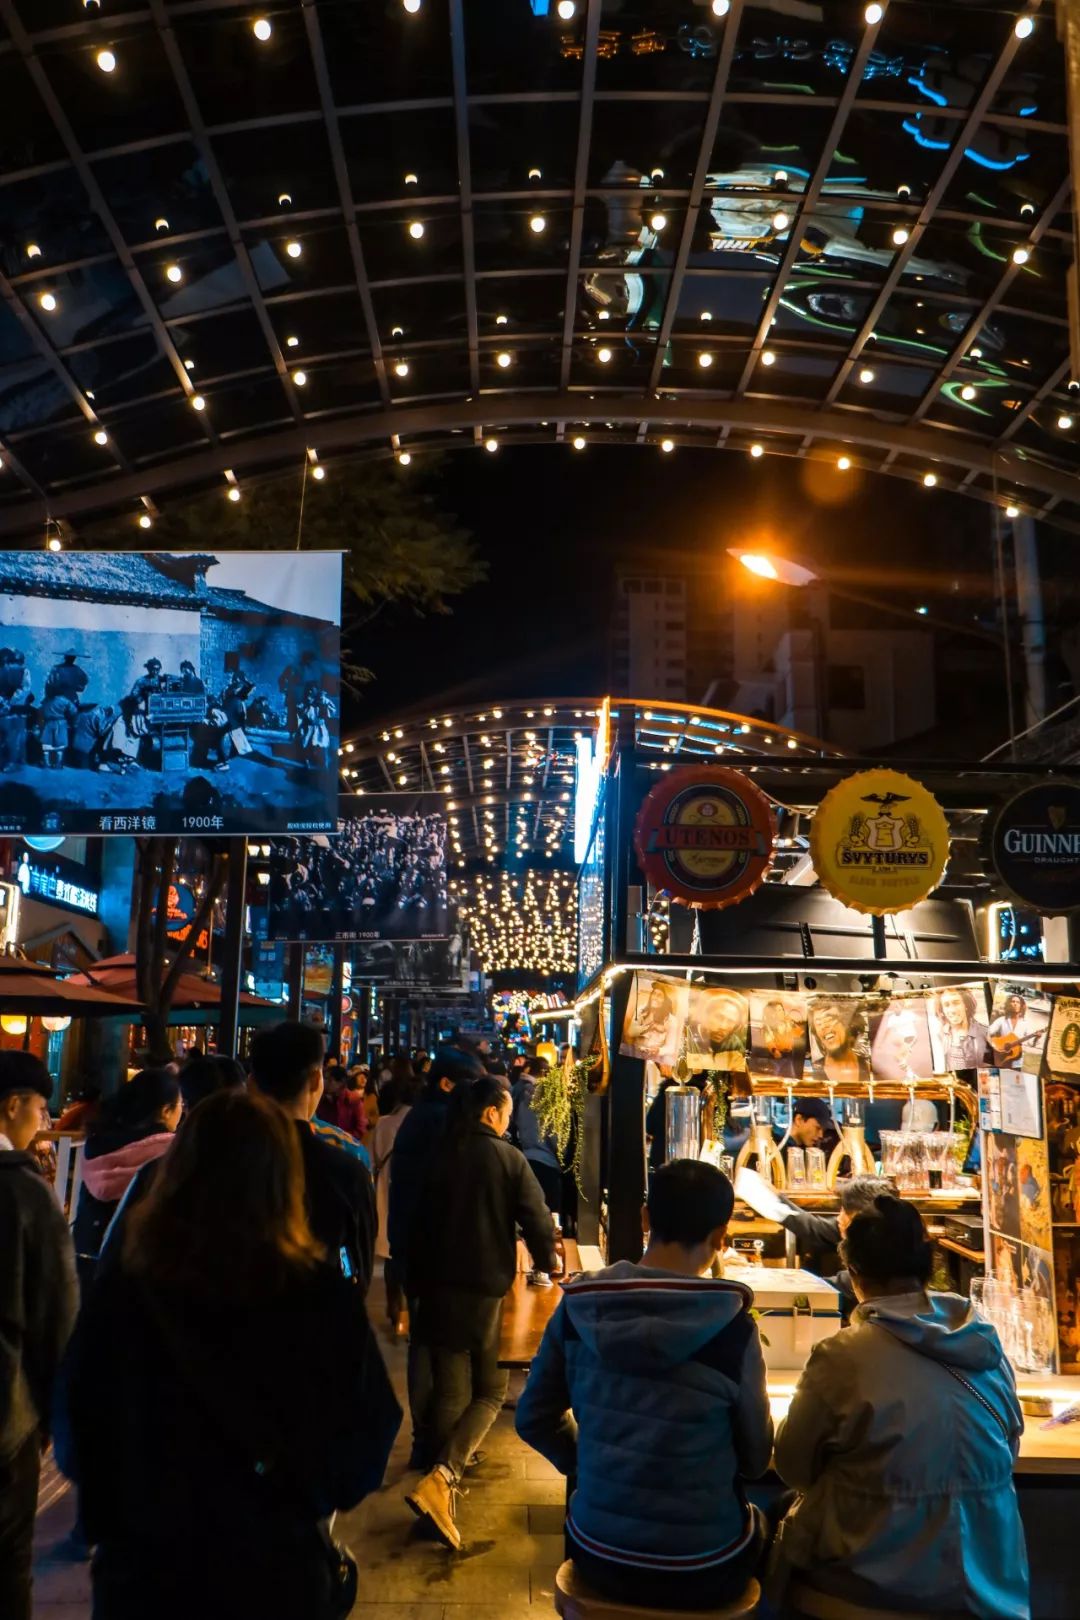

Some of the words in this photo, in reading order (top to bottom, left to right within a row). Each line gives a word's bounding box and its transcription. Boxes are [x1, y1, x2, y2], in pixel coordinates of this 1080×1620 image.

[99, 815, 156, 830] 看西洋镜
[181, 815, 224, 829] 1900年
[666, 828, 750, 846] UTENOS
